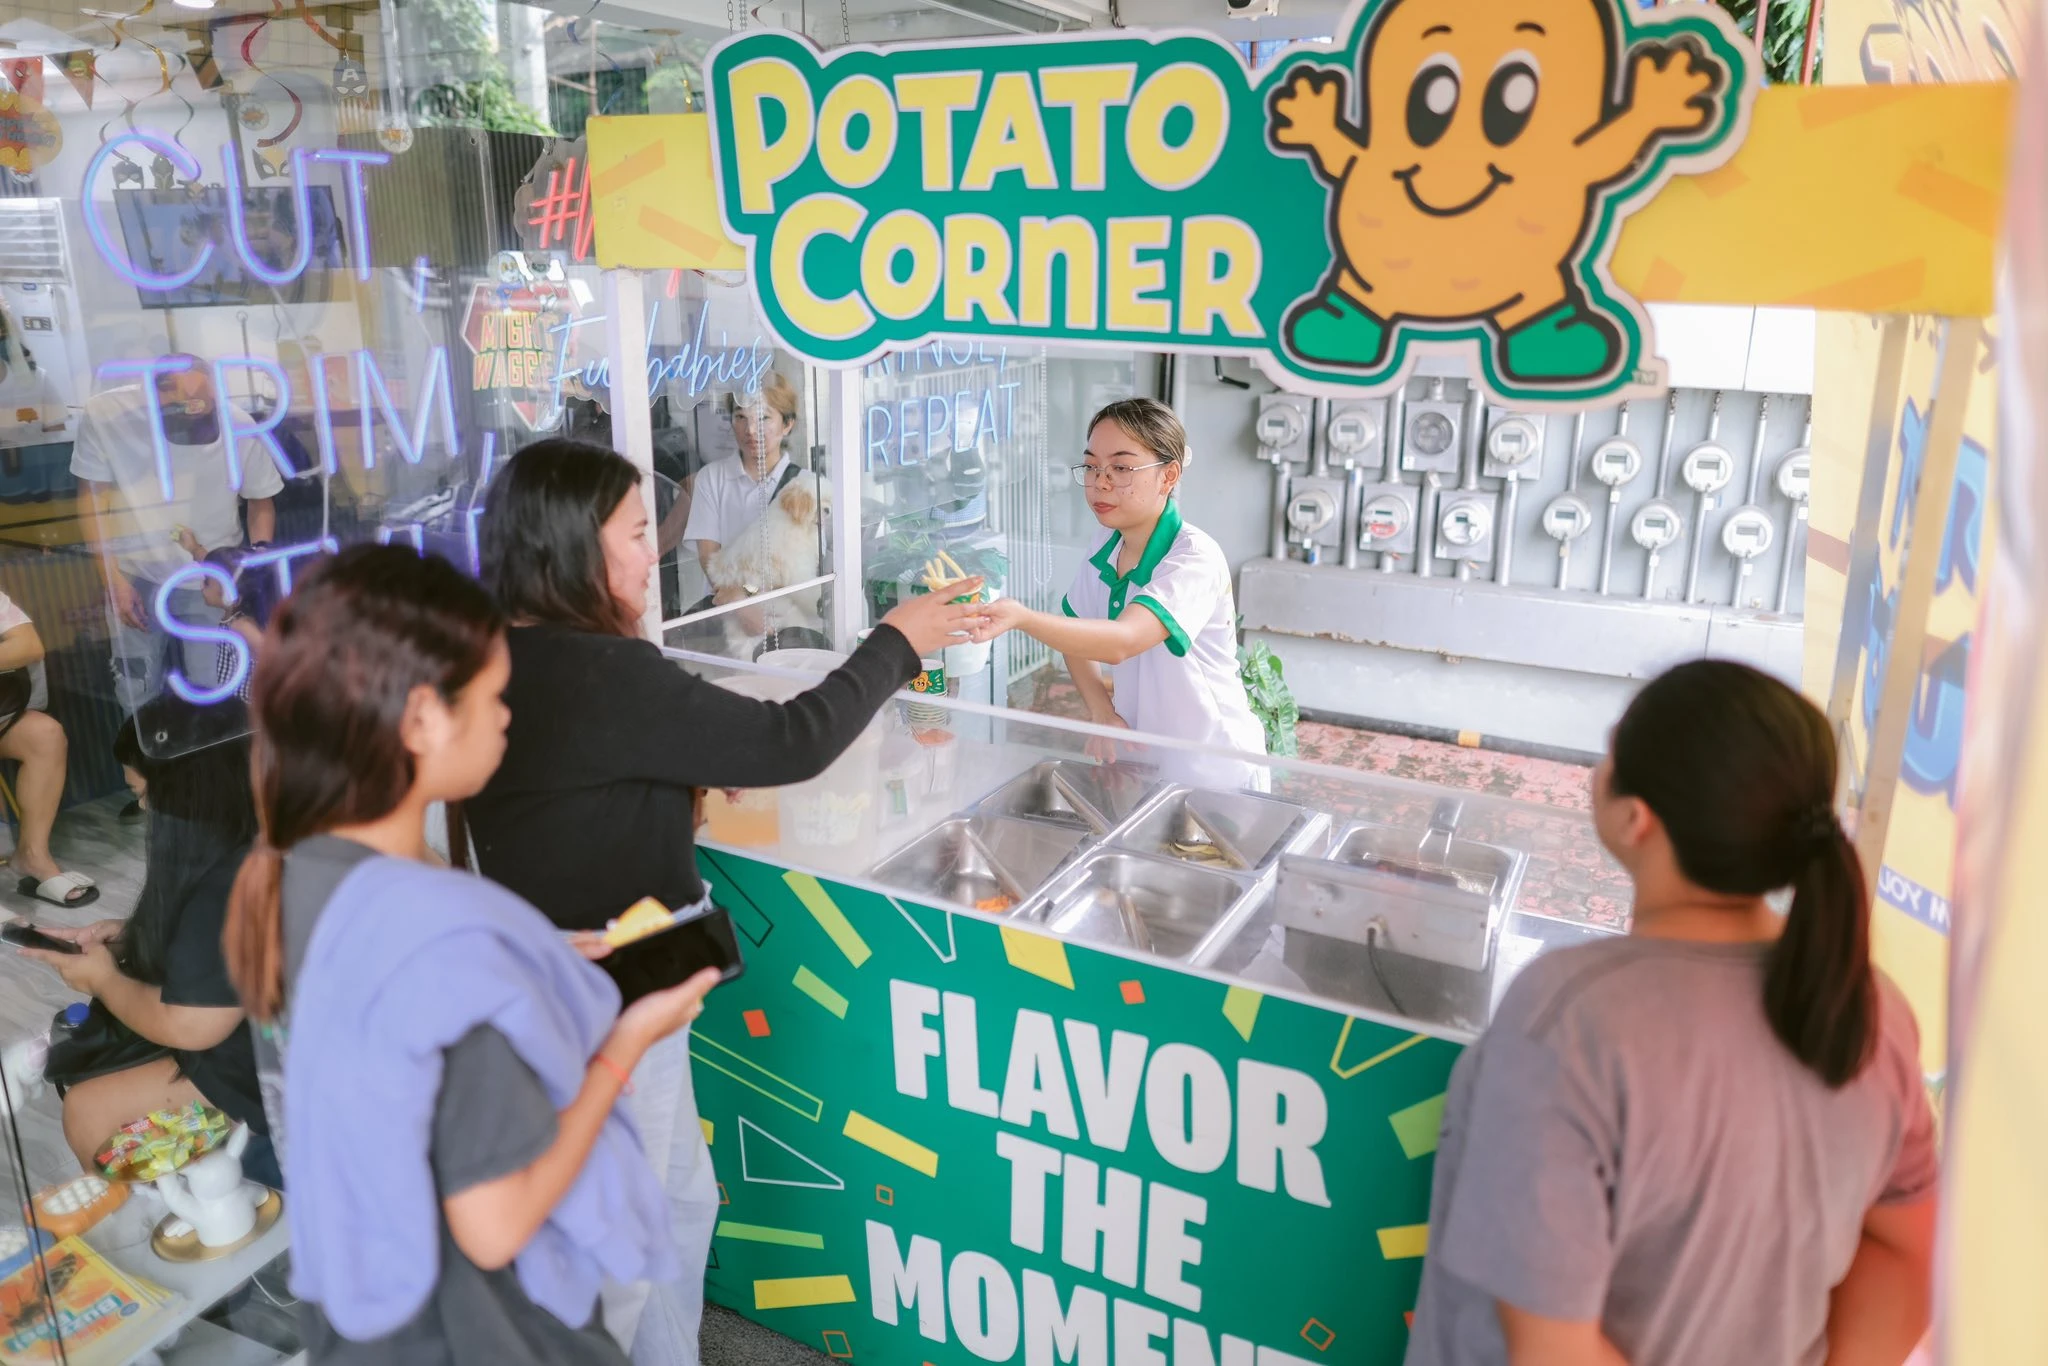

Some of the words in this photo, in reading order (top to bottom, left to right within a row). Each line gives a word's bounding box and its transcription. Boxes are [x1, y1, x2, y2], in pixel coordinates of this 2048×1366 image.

[728, 56, 1230, 214] POTATO
[479, 311, 568, 352] MIGHT
[770, 192, 1266, 341] CORNER
[864, 382, 1021, 472] REPEAT
[1879, 870, 1923, 912] JOY
[889, 979, 1332, 1208] FLAVOR
[865, 1219, 1332, 1366] MOME
[996, 1131, 1208, 1313] THE
